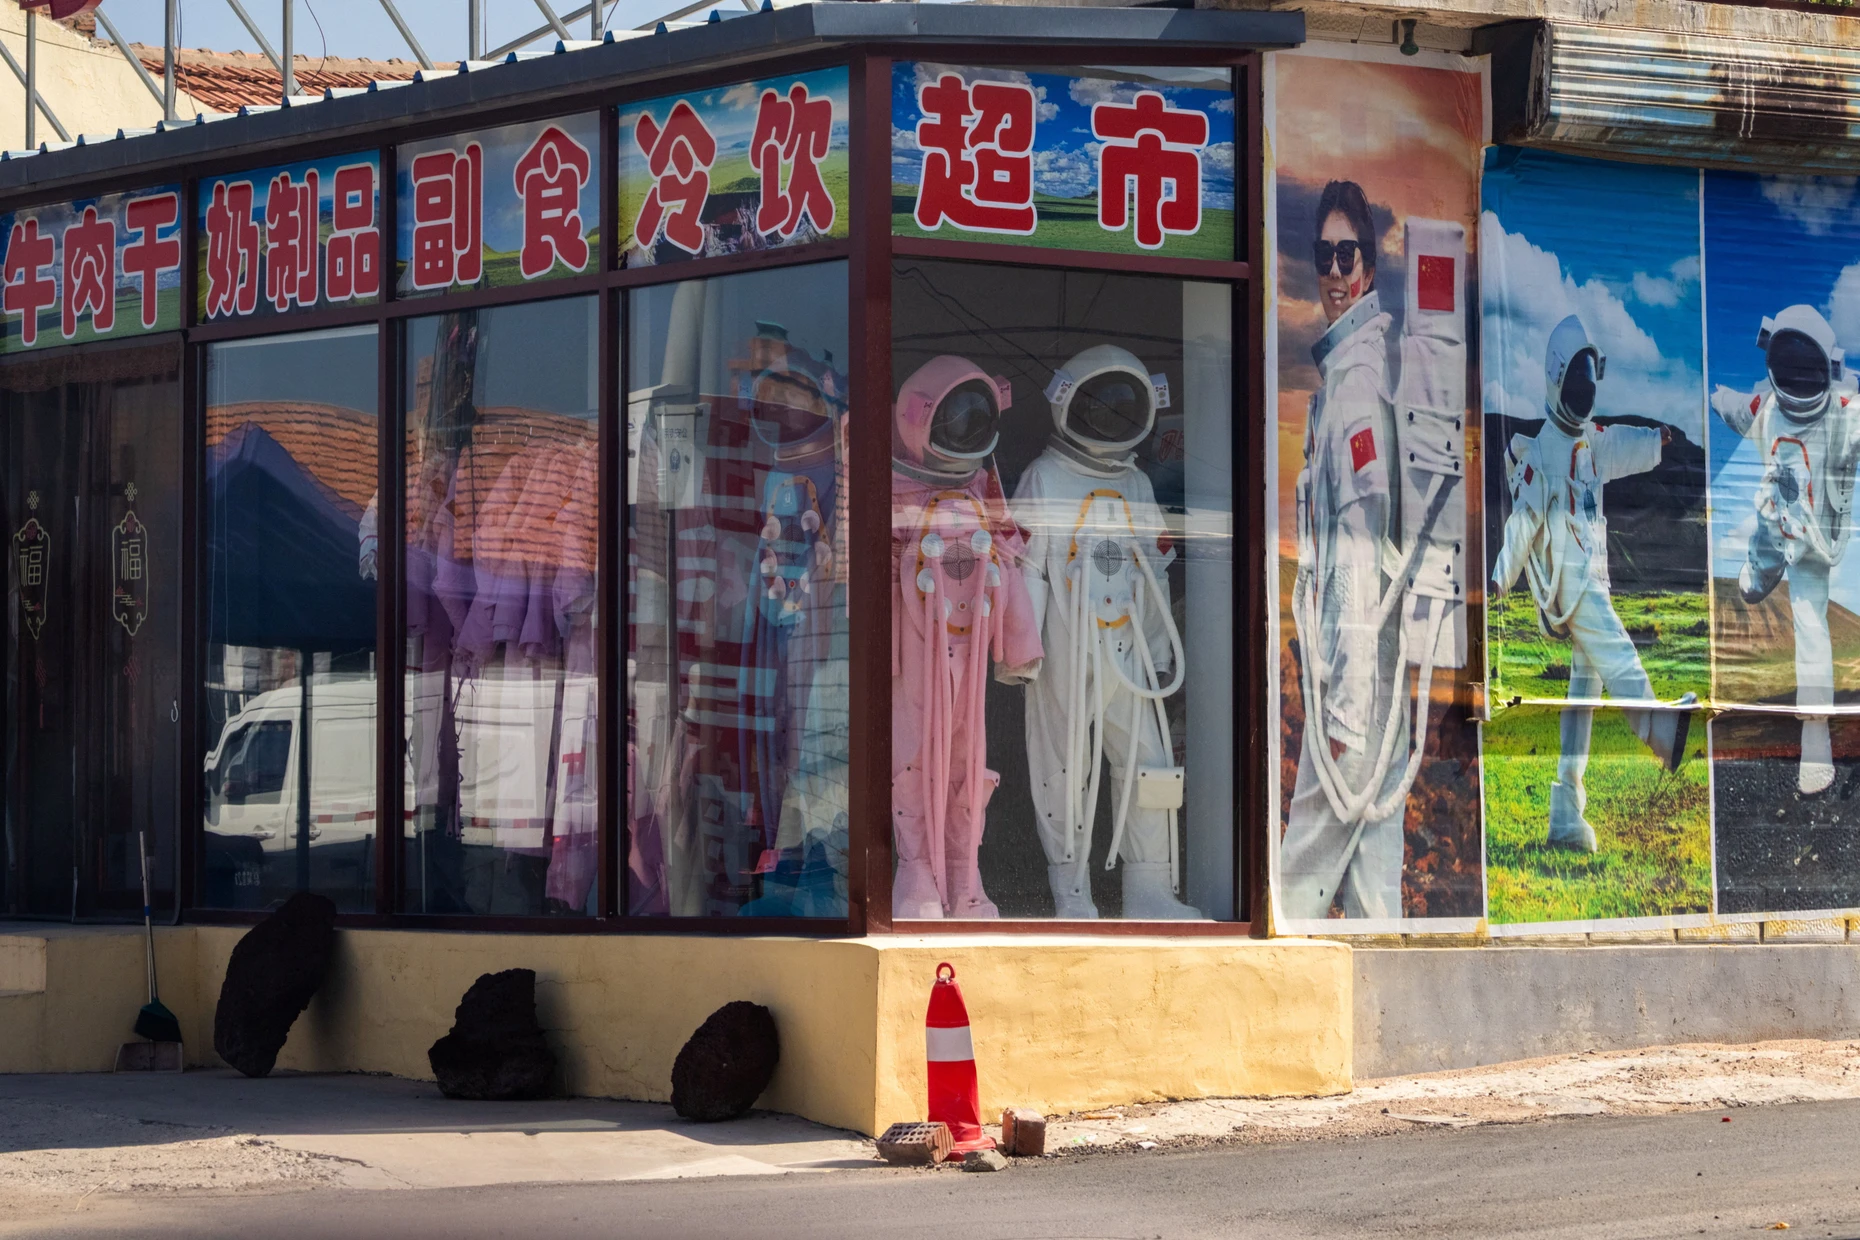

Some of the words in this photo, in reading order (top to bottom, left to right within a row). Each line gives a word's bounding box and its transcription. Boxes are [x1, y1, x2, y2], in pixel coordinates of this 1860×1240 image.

[412, 125, 591, 290] 副食
[635, 81, 835, 255] 冷饮
[915, 71, 1210, 250] 超市
[4, 191, 181, 347] 牛肉干
[206, 162, 380, 320] 奶制品
[20, 546, 43, 587] 福
[121, 539, 141, 580] 福
